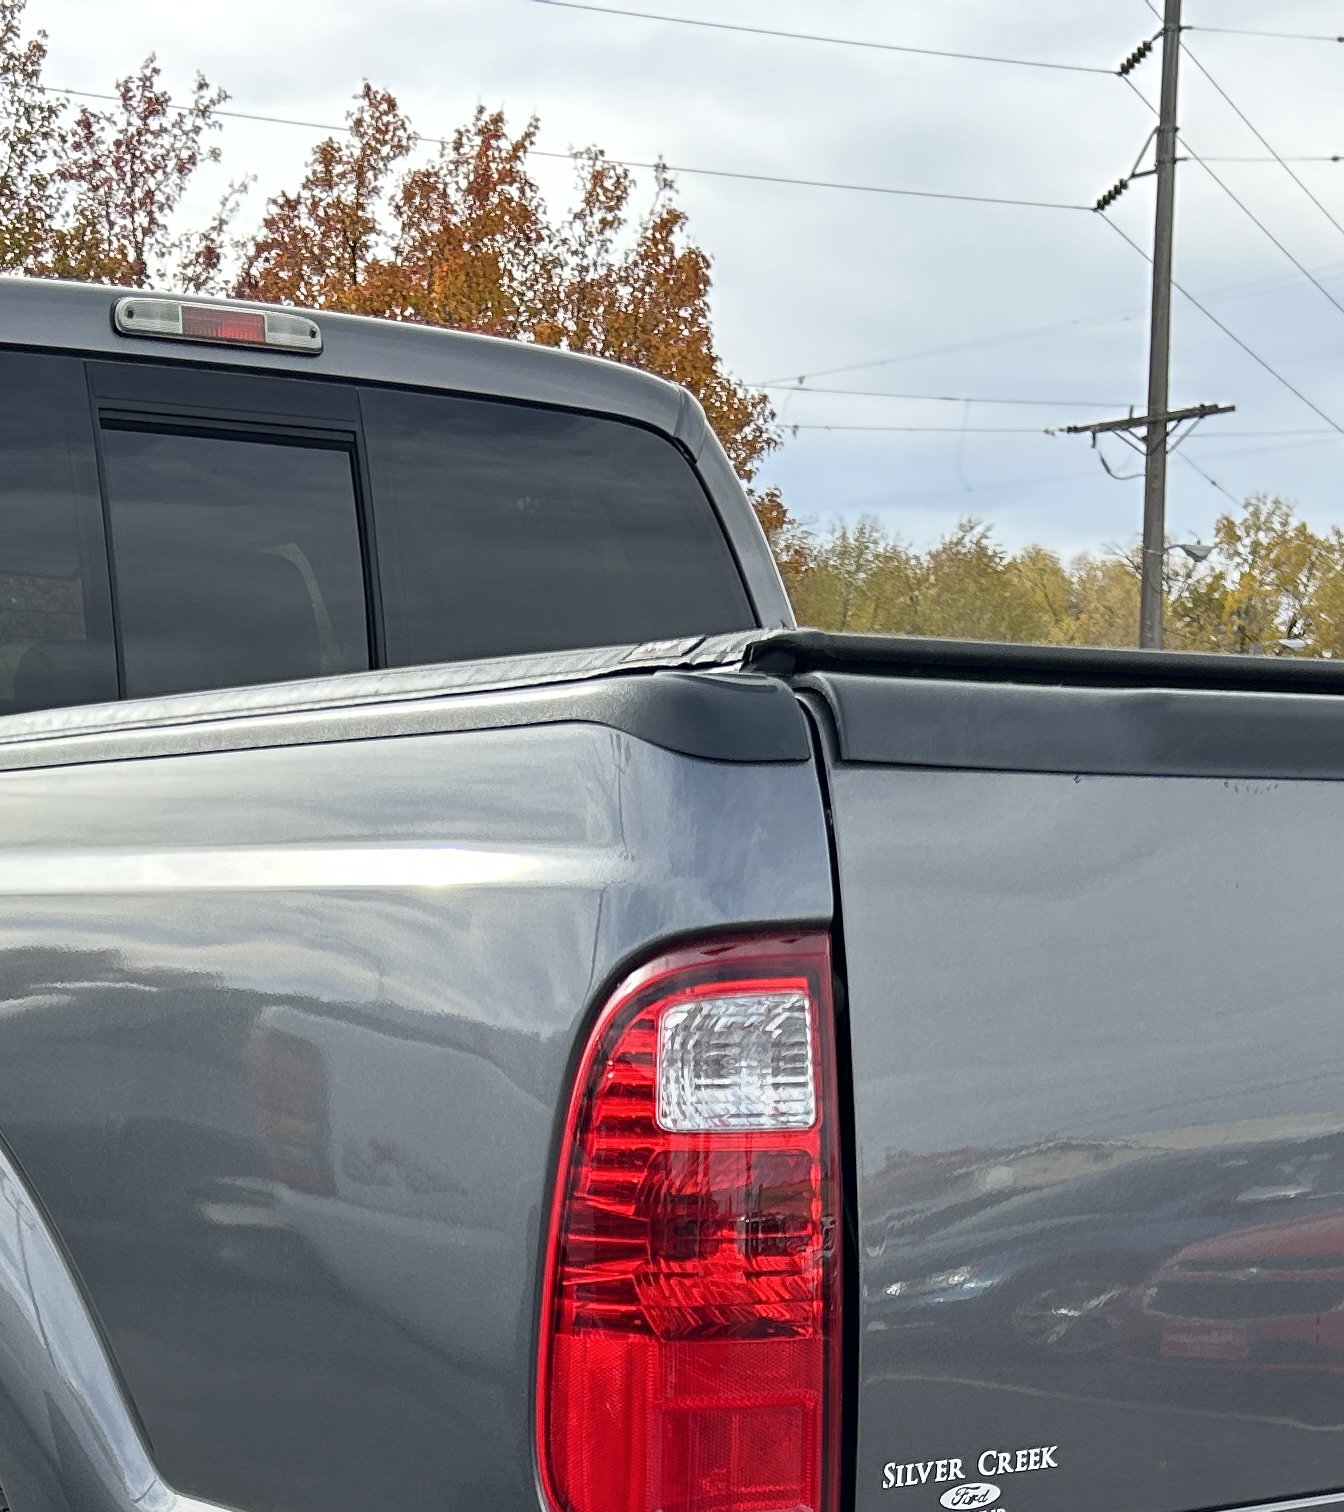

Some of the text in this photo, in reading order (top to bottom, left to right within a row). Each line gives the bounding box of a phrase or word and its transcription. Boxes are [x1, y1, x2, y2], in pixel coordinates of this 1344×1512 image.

[882, 1445, 1059, 1489] SILVER CREEK
[950, 1485, 991, 1506] Ford
